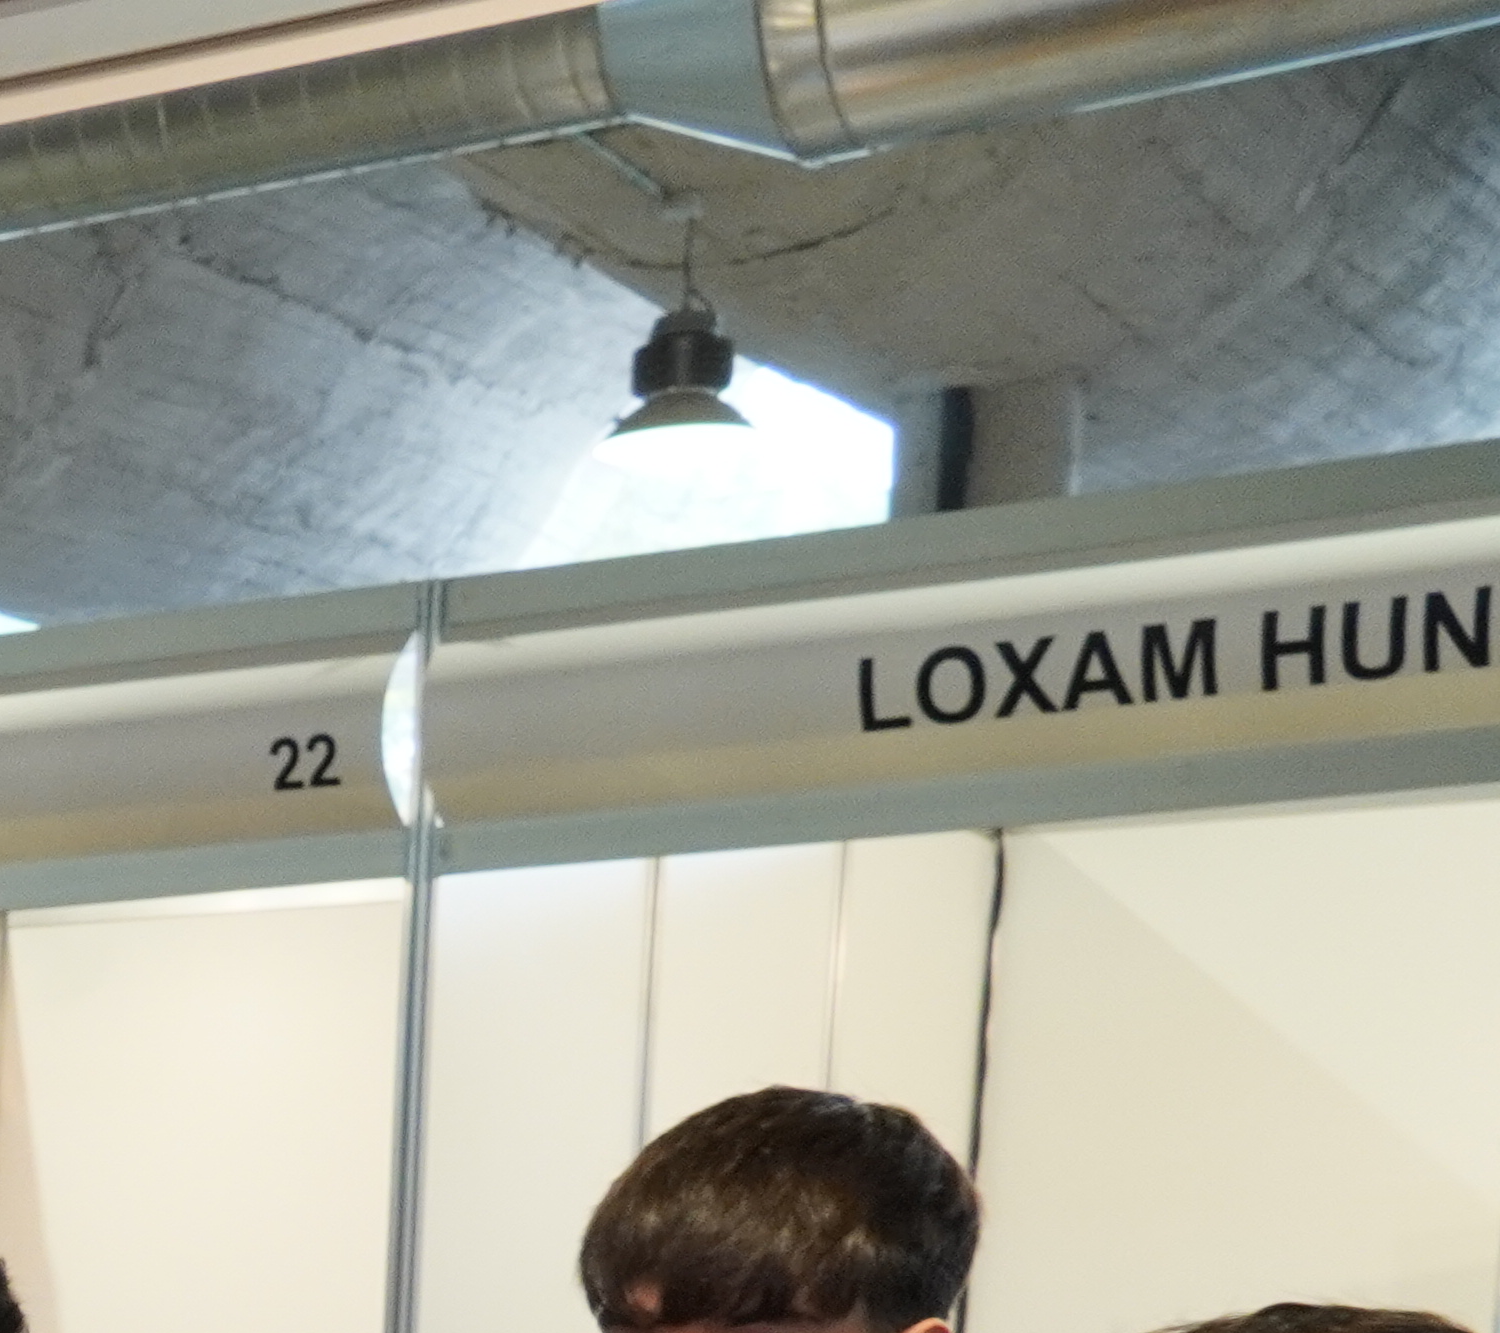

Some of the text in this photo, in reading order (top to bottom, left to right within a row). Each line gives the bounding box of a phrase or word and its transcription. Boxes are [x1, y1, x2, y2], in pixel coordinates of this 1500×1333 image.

[858, 584, 1492, 732] LOXAM HUN
[268, 734, 341, 792] 22
